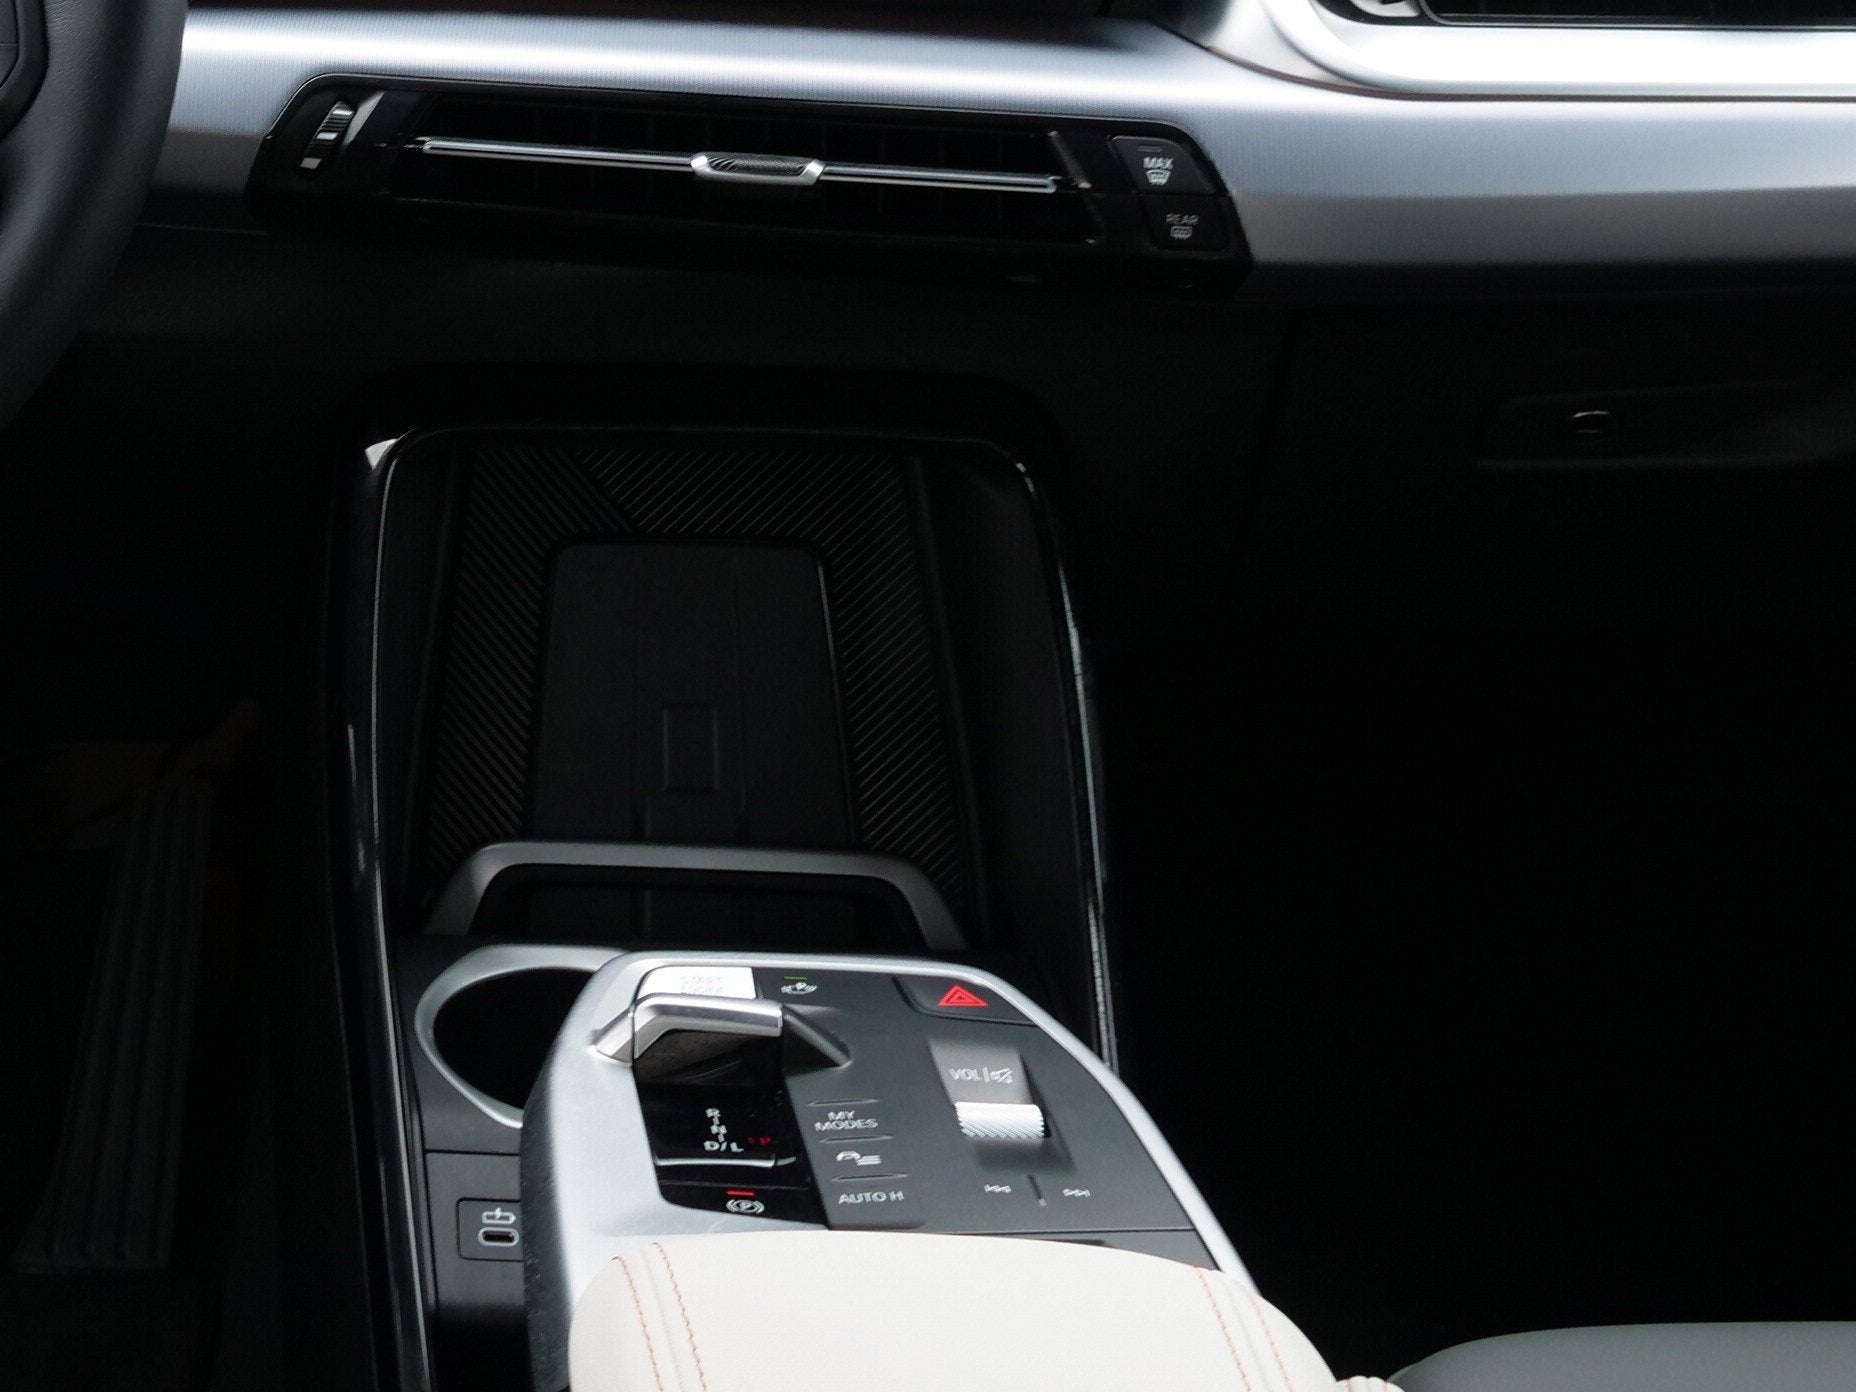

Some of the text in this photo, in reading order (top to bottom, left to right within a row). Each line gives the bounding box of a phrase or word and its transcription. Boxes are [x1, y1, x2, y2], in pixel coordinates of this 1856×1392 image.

[949, 1068, 981, 1082] VOL
[705, 1109, 722, 1118] R
[828, 1111, 856, 1120] MY
[814, 1121, 879, 1131] MODES
[839, 1191, 904, 1204] AUTO H
